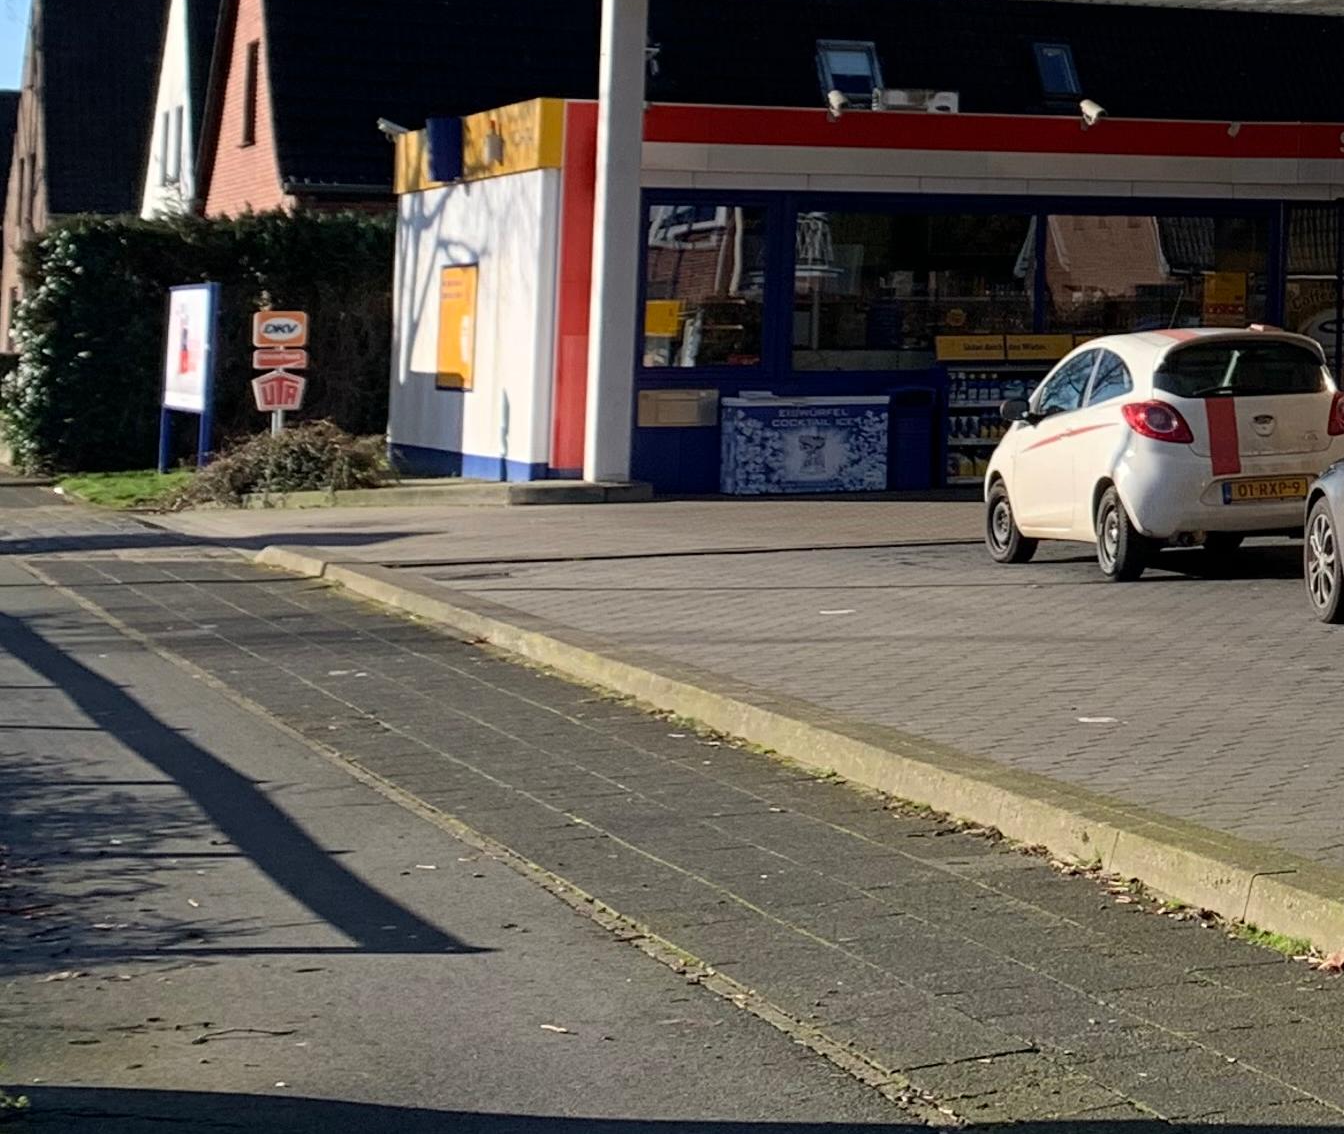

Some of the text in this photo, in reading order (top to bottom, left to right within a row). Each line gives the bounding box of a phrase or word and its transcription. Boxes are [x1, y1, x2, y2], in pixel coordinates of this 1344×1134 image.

[263, 323, 298, 334] DKV
[260, 376, 300, 405] UTA
[1237, 481, 1301, 498] 01-RXP-9
